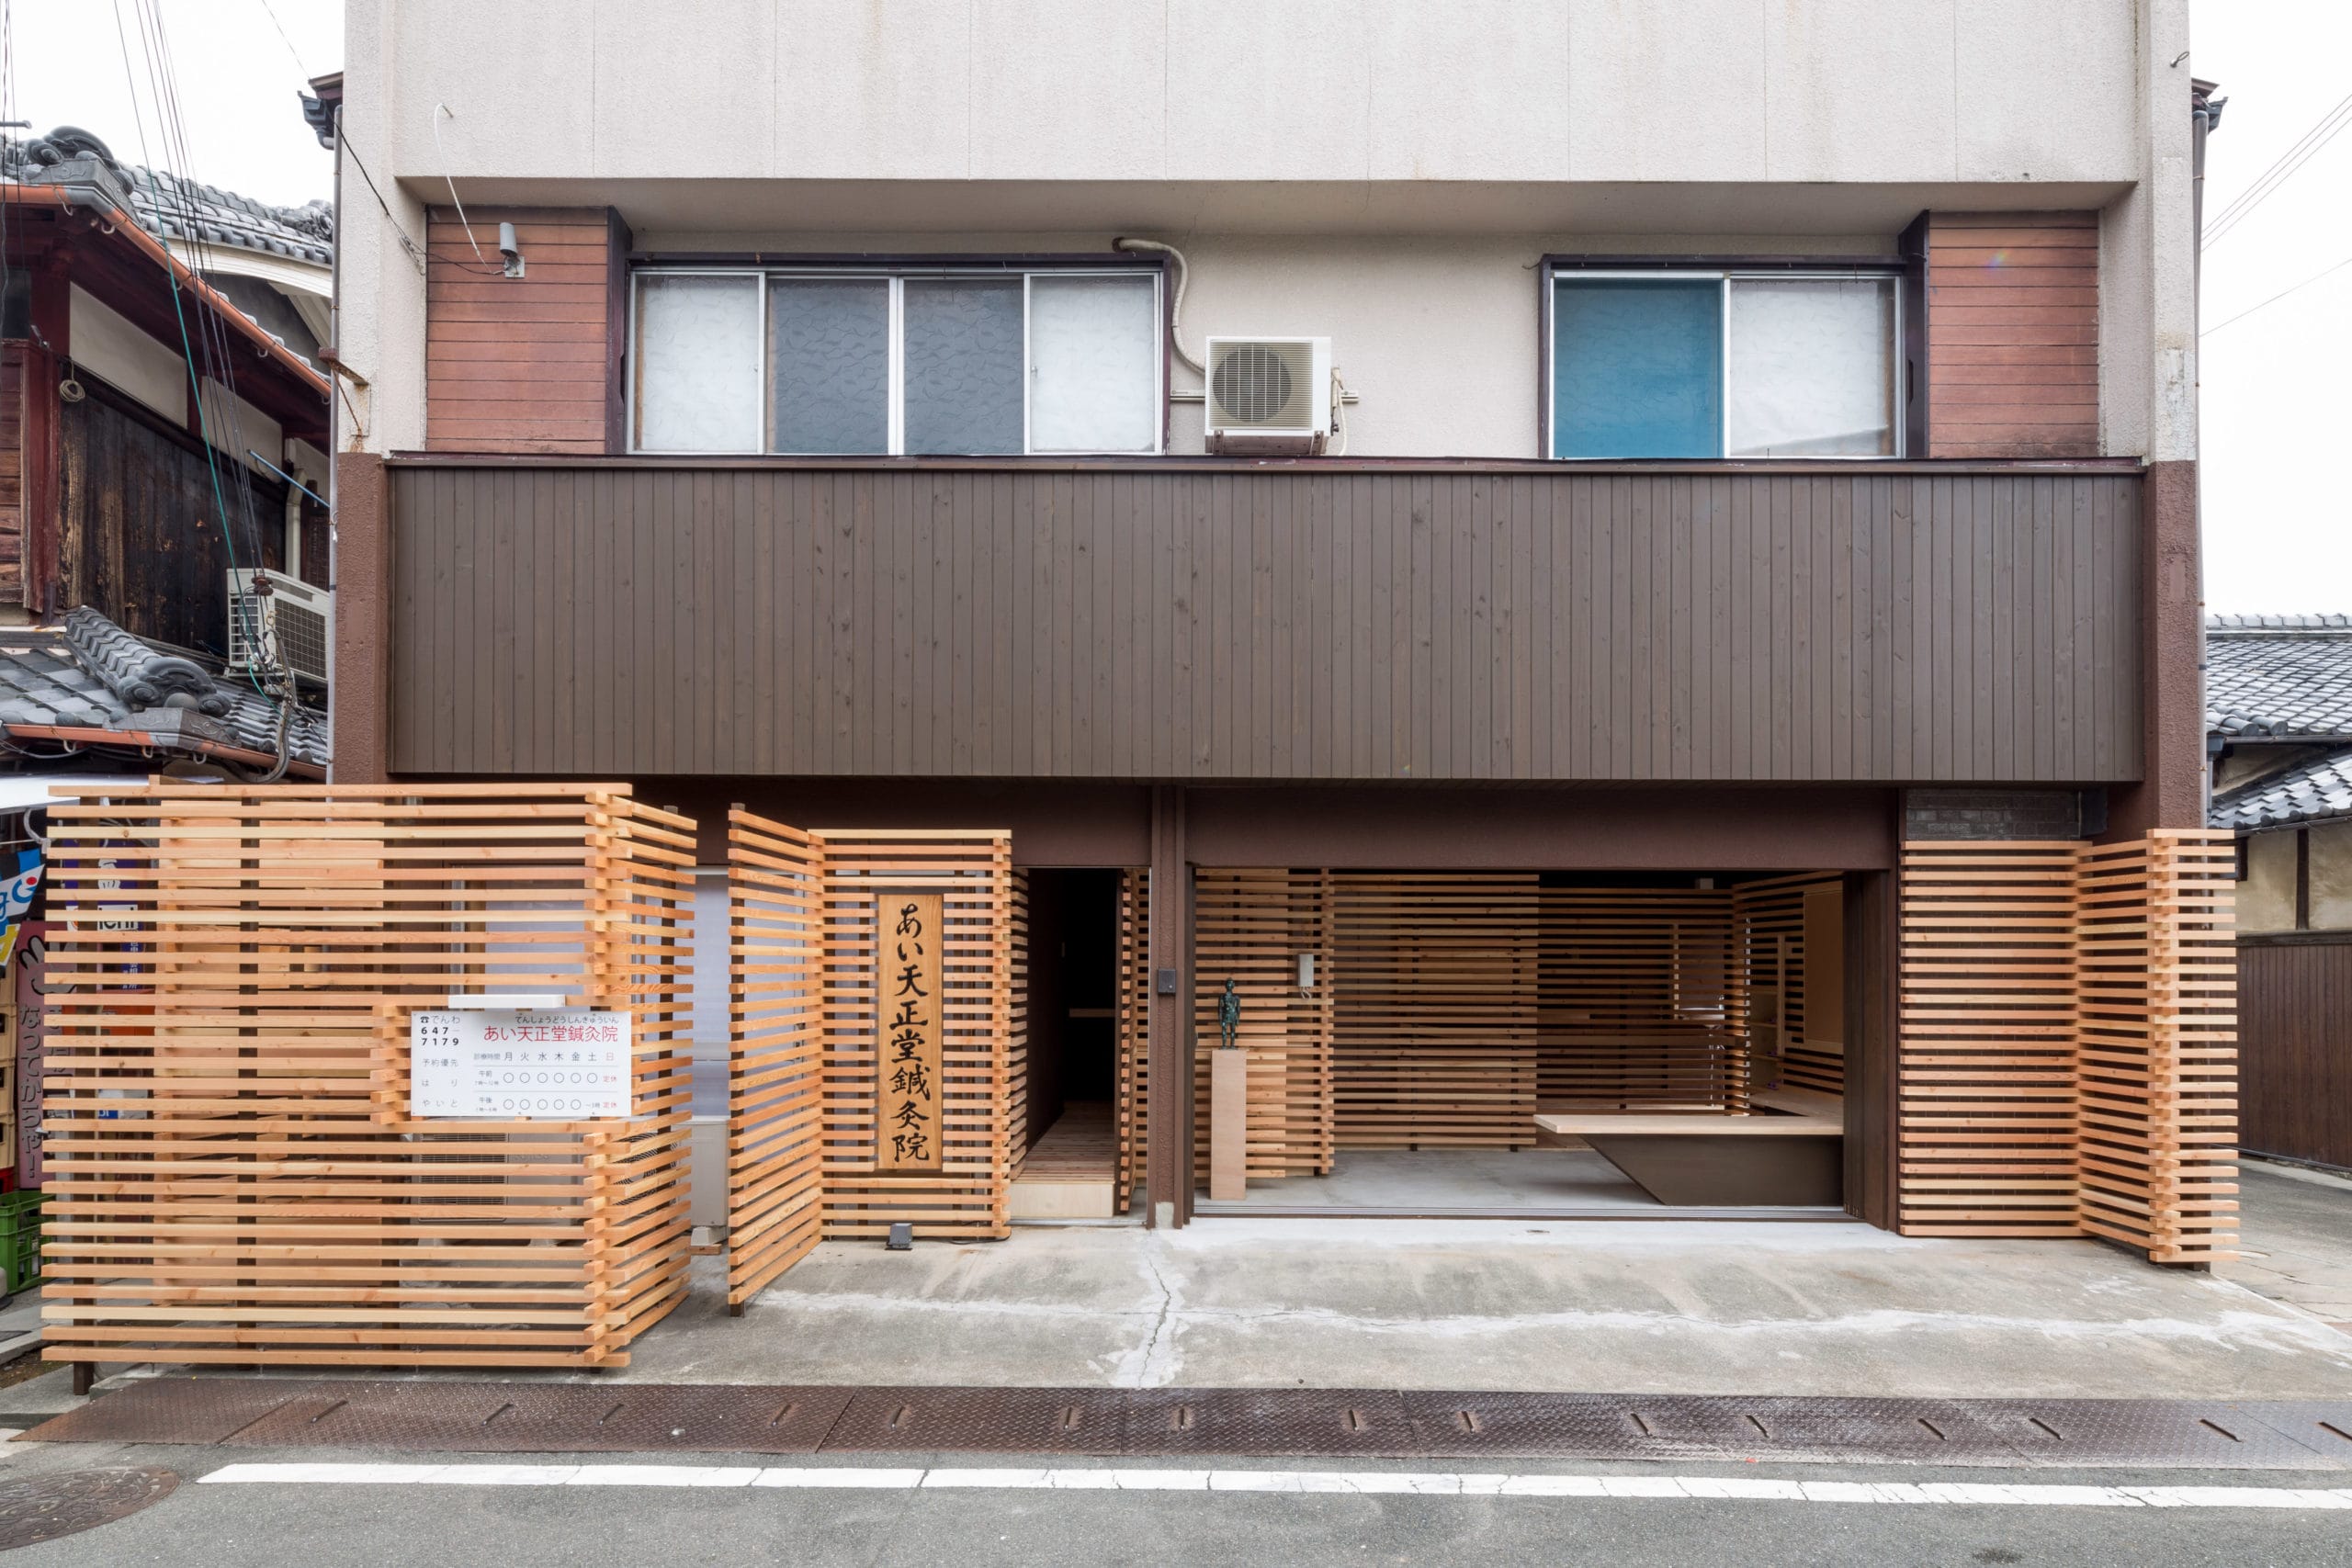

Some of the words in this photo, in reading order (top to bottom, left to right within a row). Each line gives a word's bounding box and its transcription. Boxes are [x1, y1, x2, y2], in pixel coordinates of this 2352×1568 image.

[431, 1015, 460, 1024] でんわ
[515, 1015, 619, 1024] てんしょうどうしんきゅういん
[483, 1025, 618, 1043] あい天正堂鍼灸院
[889, 904, 930, 1162] あい天正堂鍼灸院
[421, 1037, 459, 1046] 7179
[503, 1052, 513, 1061] 月
[520, 1052, 529, 1061] 火
[537, 1052, 548, 1061] 水
[554, 1052, 564, 1061] 木
[571, 1052, 581, 1061] 金
[588, 1052, 597, 1061] 土
[605, 1052, 615, 1061] 日
